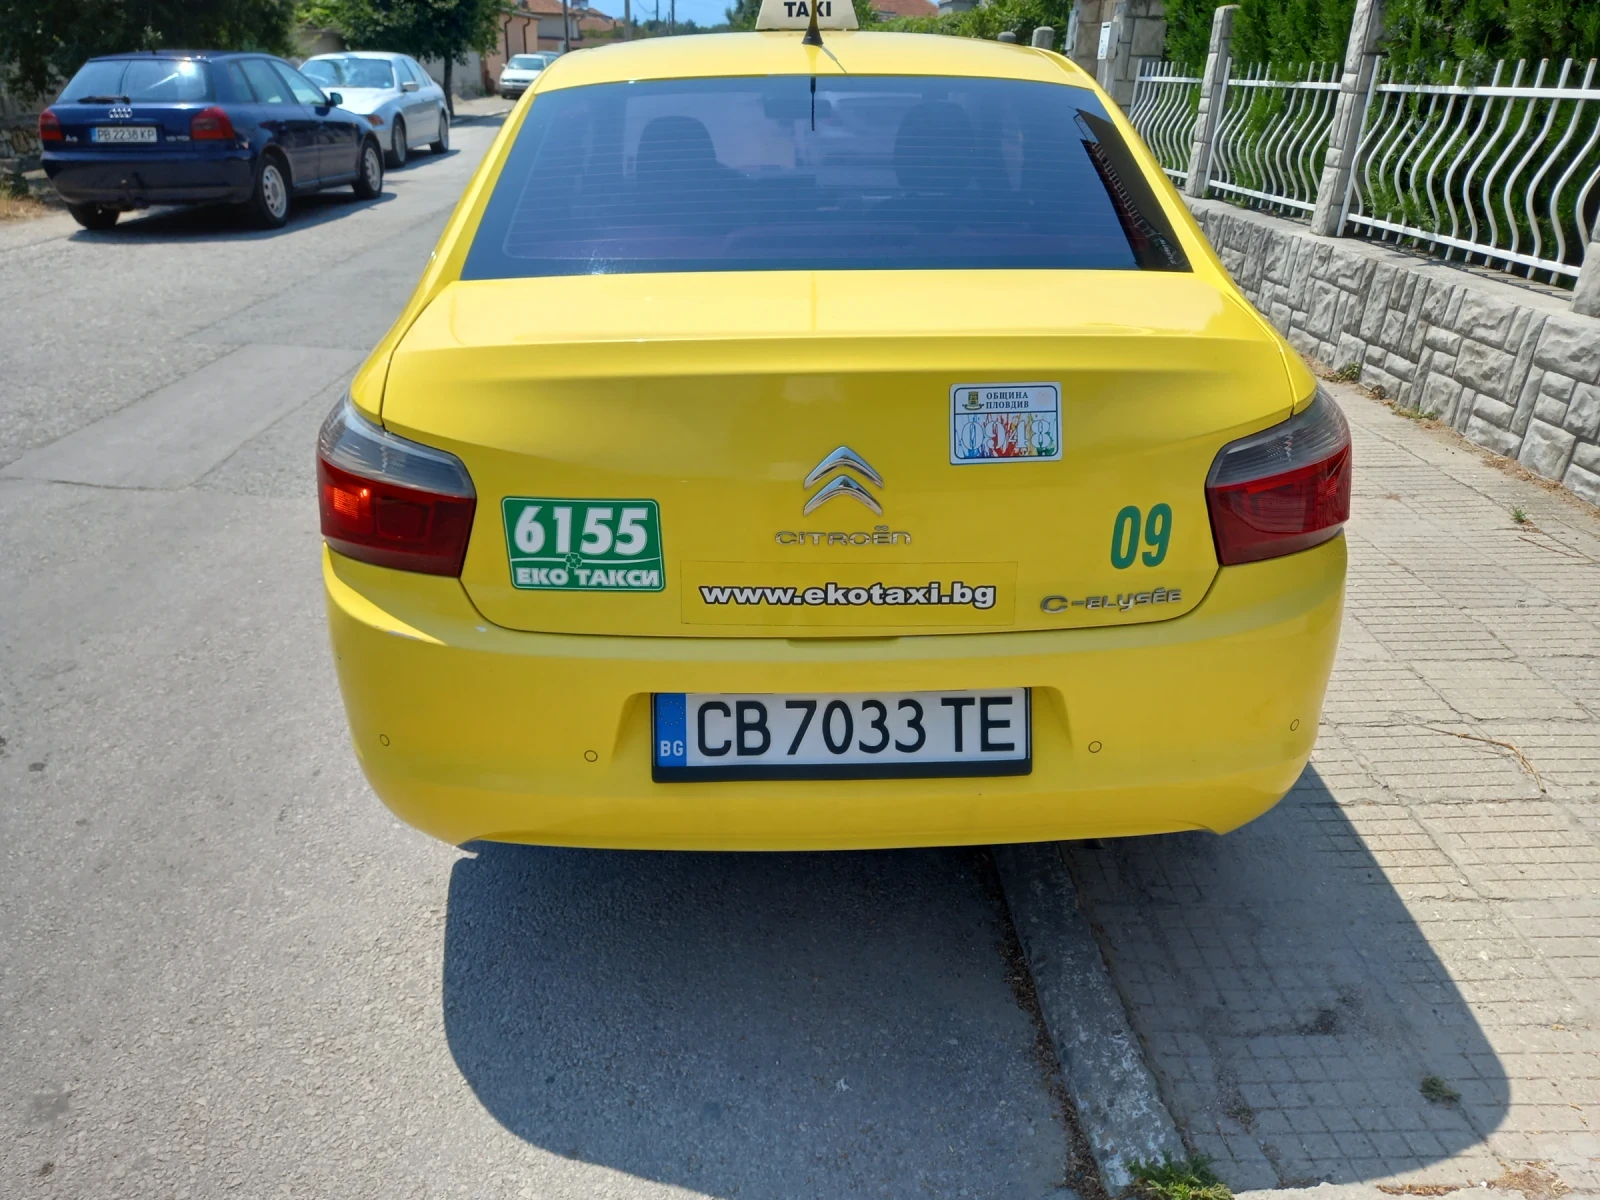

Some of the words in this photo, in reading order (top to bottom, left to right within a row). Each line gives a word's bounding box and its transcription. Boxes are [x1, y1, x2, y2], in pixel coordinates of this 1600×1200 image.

[986, 391, 1028, 400] ОБЩИНА
[986, 400, 1029, 409] ПЛОВДИВ
[961, 420, 1051, 452] 0948
[514, 505, 648, 556] 6155
[1110, 503, 1173, 570] 09
[516, 567, 569, 585] ЕКО
[574, 569, 660, 587] ТАКСИ
[698, 582, 996, 609] www.ekotaxi.bg
[697, 700, 771, 757] CB
[785, 699, 927, 756] 7033
[941, 696, 1016, 752] TE
[660, 740, 684, 757] BG
